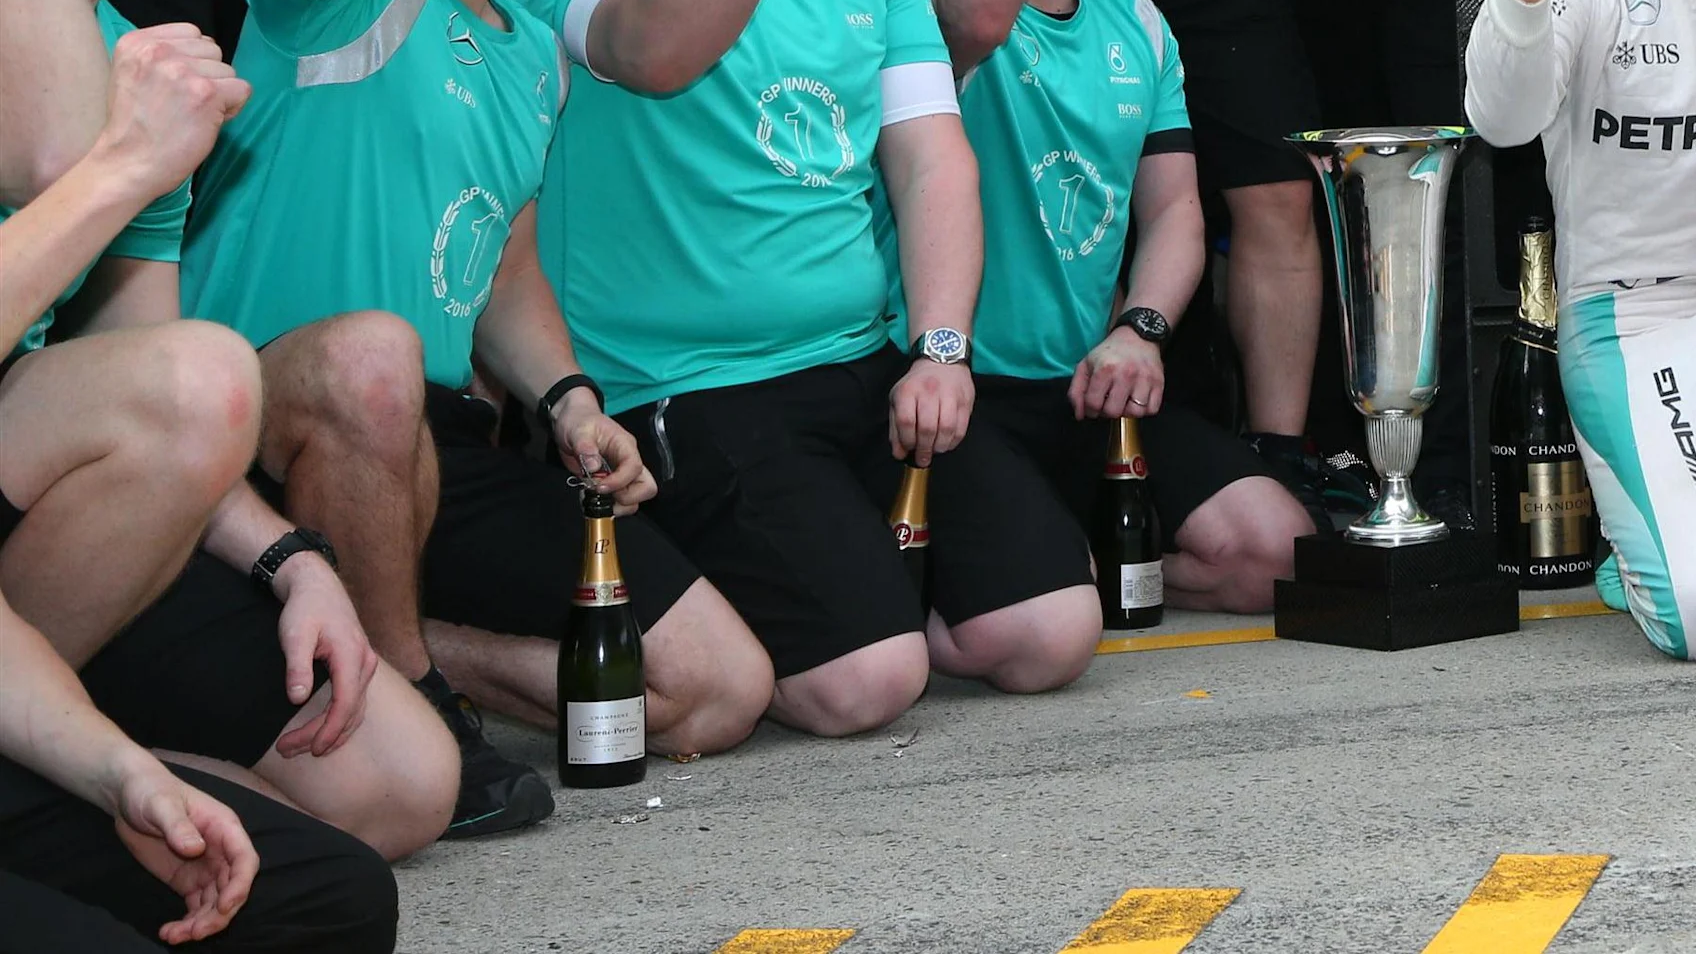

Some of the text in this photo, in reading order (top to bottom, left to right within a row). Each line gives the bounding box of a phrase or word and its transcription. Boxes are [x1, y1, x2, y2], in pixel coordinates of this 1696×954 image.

[1642, 43, 1681, 65] UBS
[760, 84, 781, 103] GP
[1117, 103, 1142, 116] BOSS
[1043, 151, 1060, 167] GP
[460, 187, 480, 204] GP
[444, 299, 472, 318] 2016
[1528, 443, 1577, 457] CHAND
[1523, 499, 1590, 514] CHANDON
[1529, 561, 1592, 576] CHANDON
